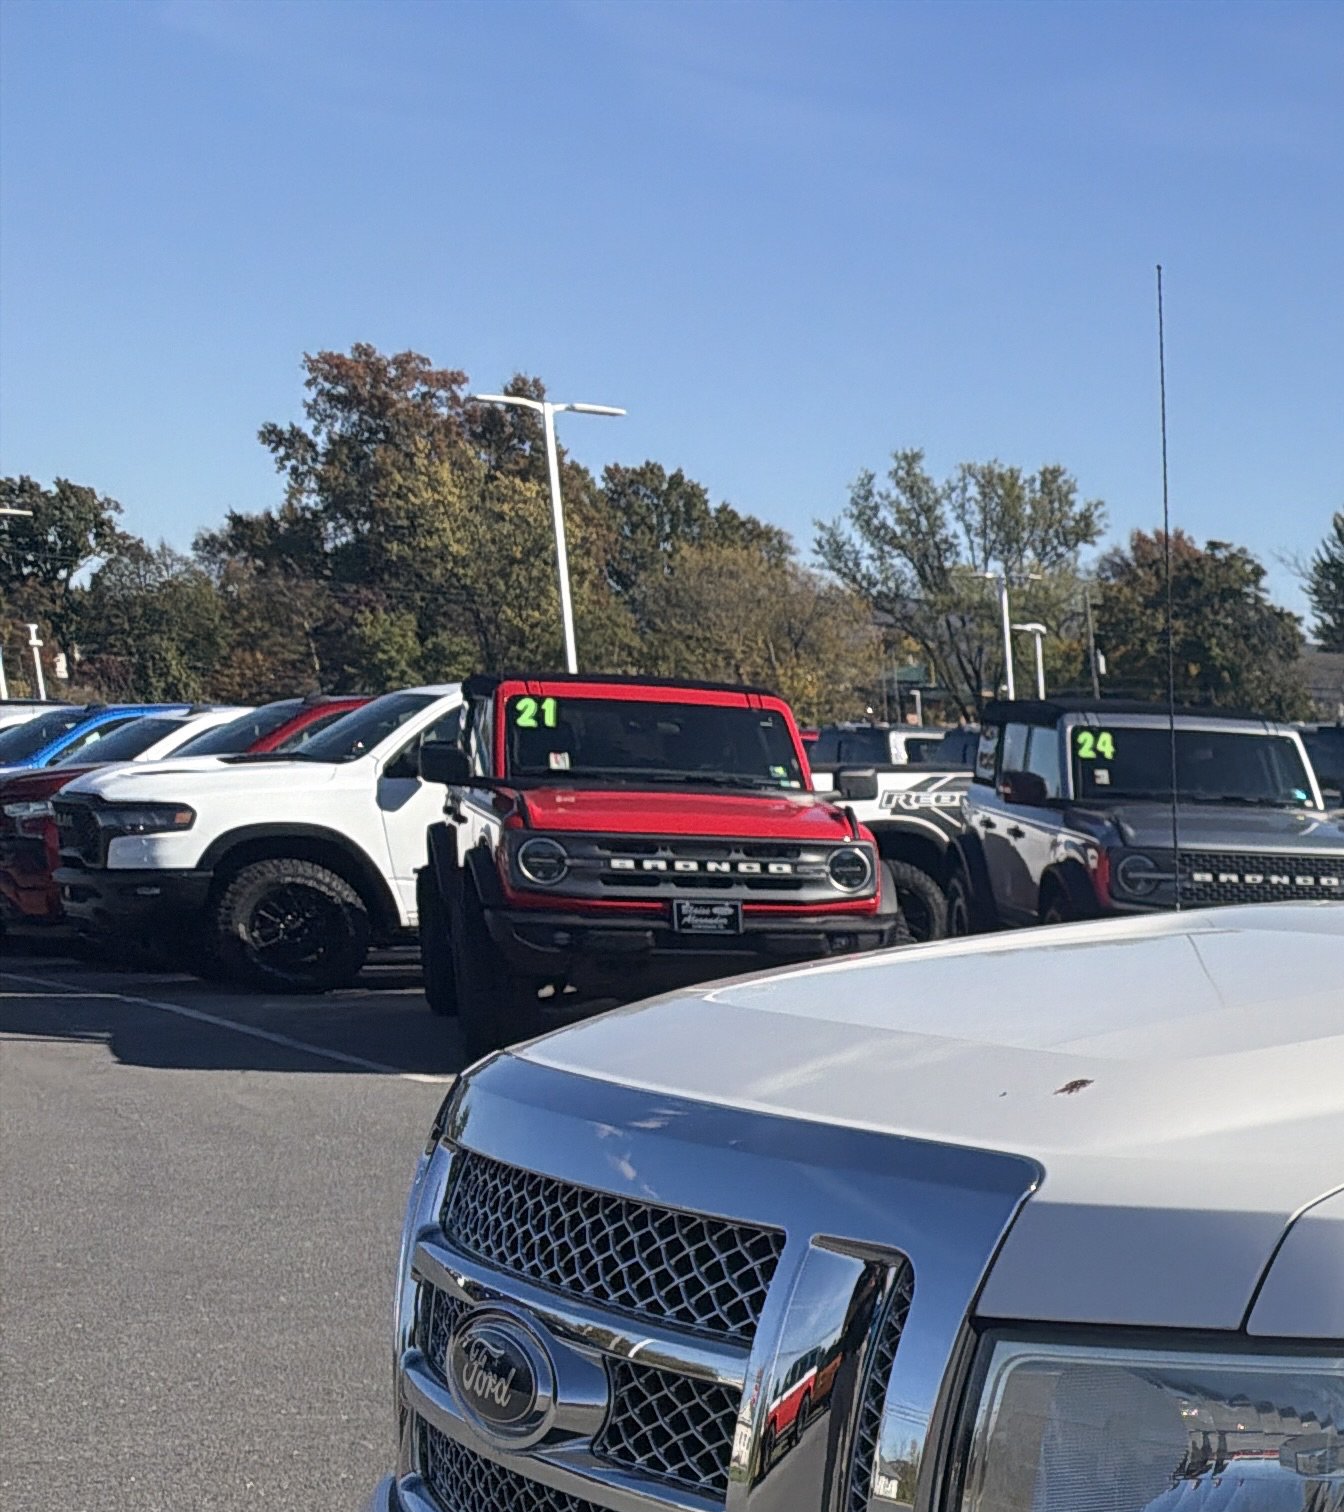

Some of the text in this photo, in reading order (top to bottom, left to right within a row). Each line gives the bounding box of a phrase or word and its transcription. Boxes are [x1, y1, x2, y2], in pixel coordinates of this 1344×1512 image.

[515, 697, 557, 728] 21
[1077, 731, 1115, 760] 24
[610, 859, 793, 873] BRONCO
[1193, 872, 1340, 887] BRONCO
[461, 1338, 517, 1407] Ford
